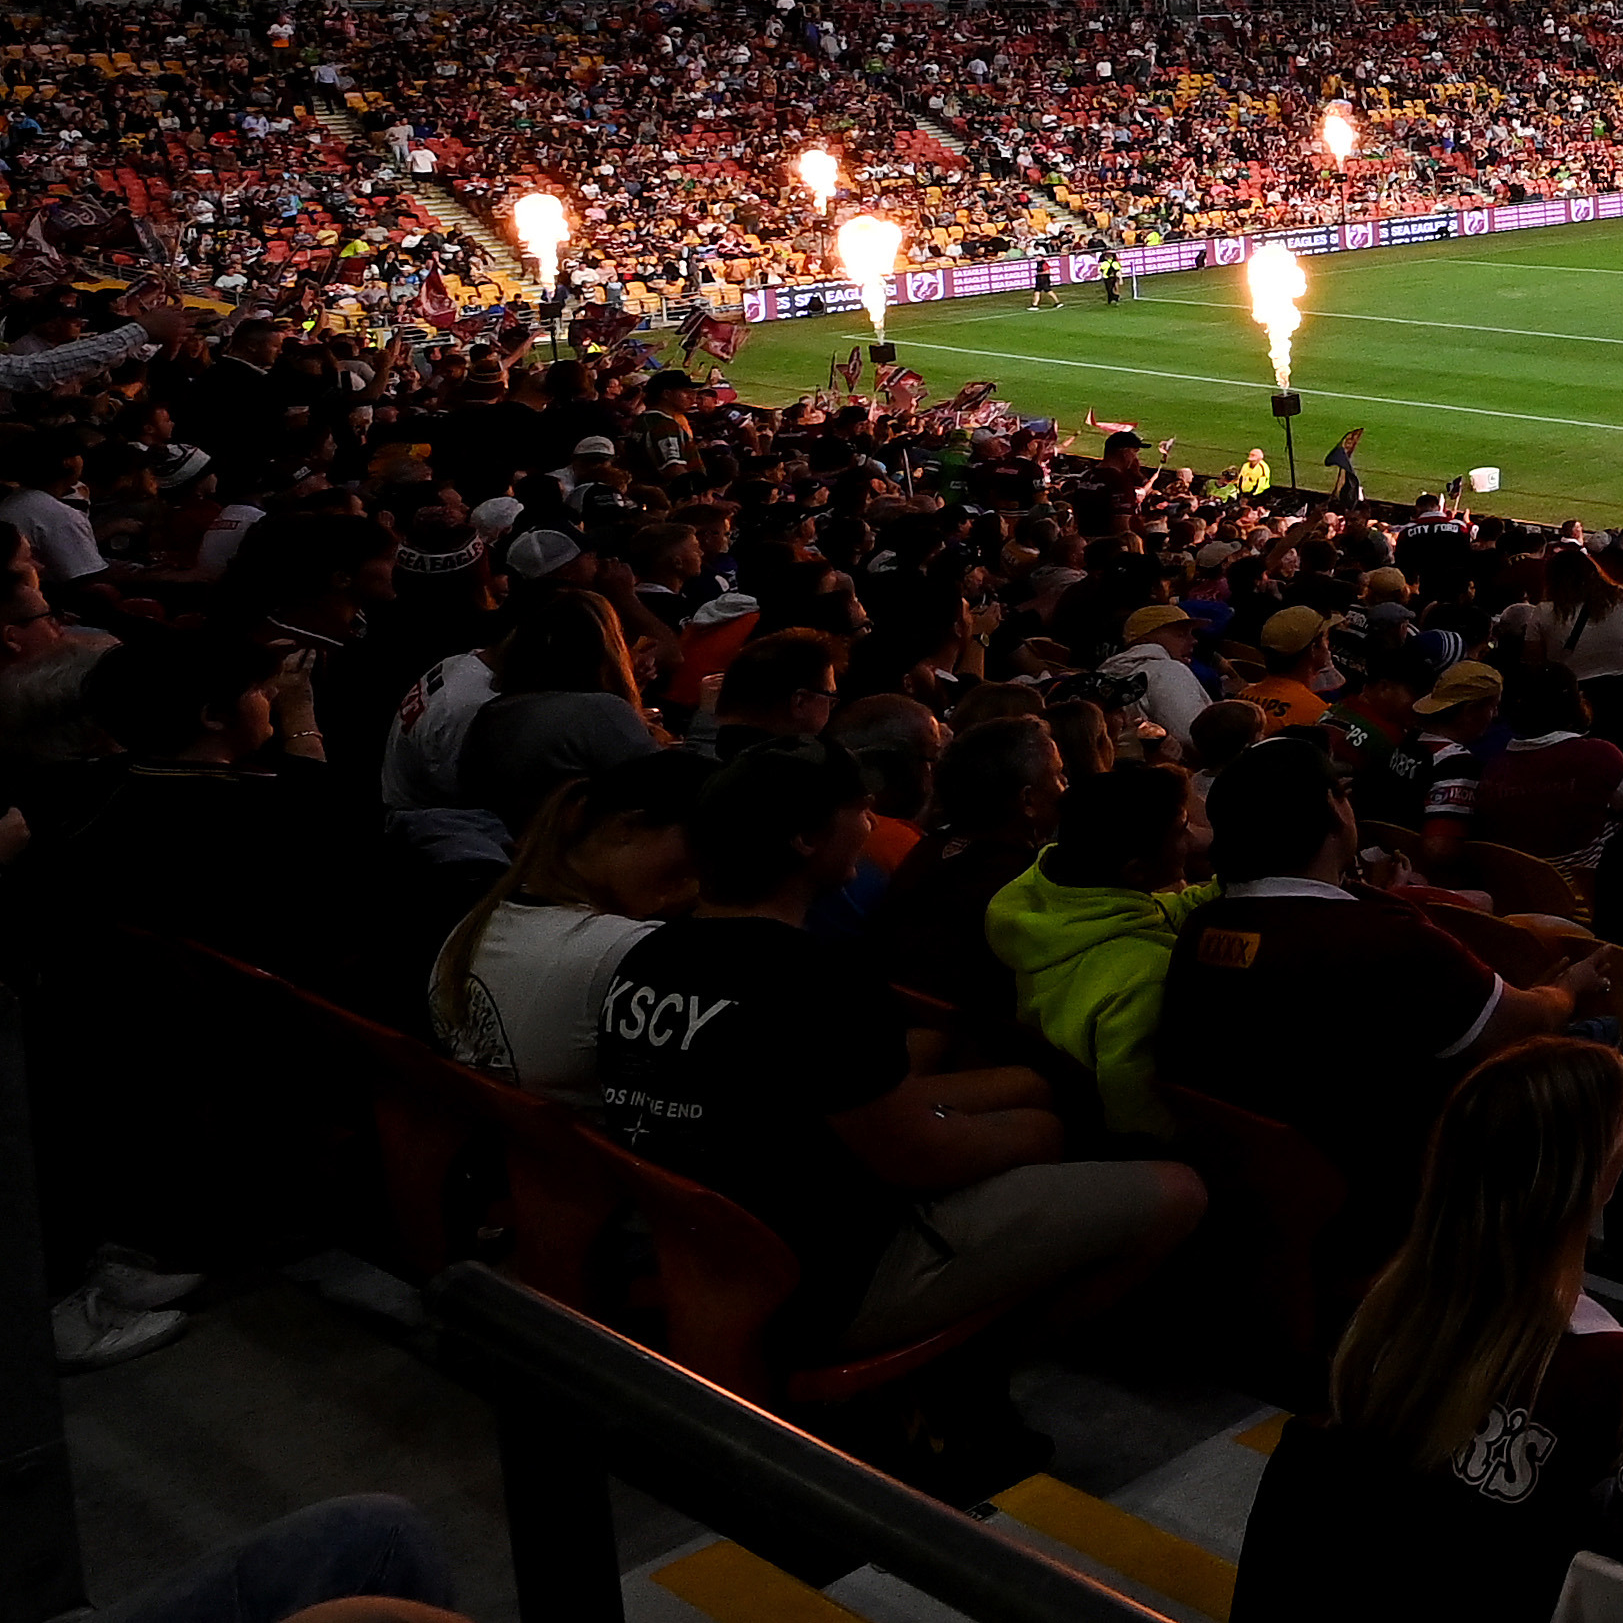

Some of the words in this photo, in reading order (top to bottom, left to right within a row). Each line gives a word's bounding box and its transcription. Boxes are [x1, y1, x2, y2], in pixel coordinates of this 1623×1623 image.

[1391, 223, 1410, 237] SEA
[1288, 234, 1327, 249] EAGLES
[1407, 523, 1429, 537] CITY
[1433, 522, 1460, 535] FORD
[667, 1099, 703, 1119] END
